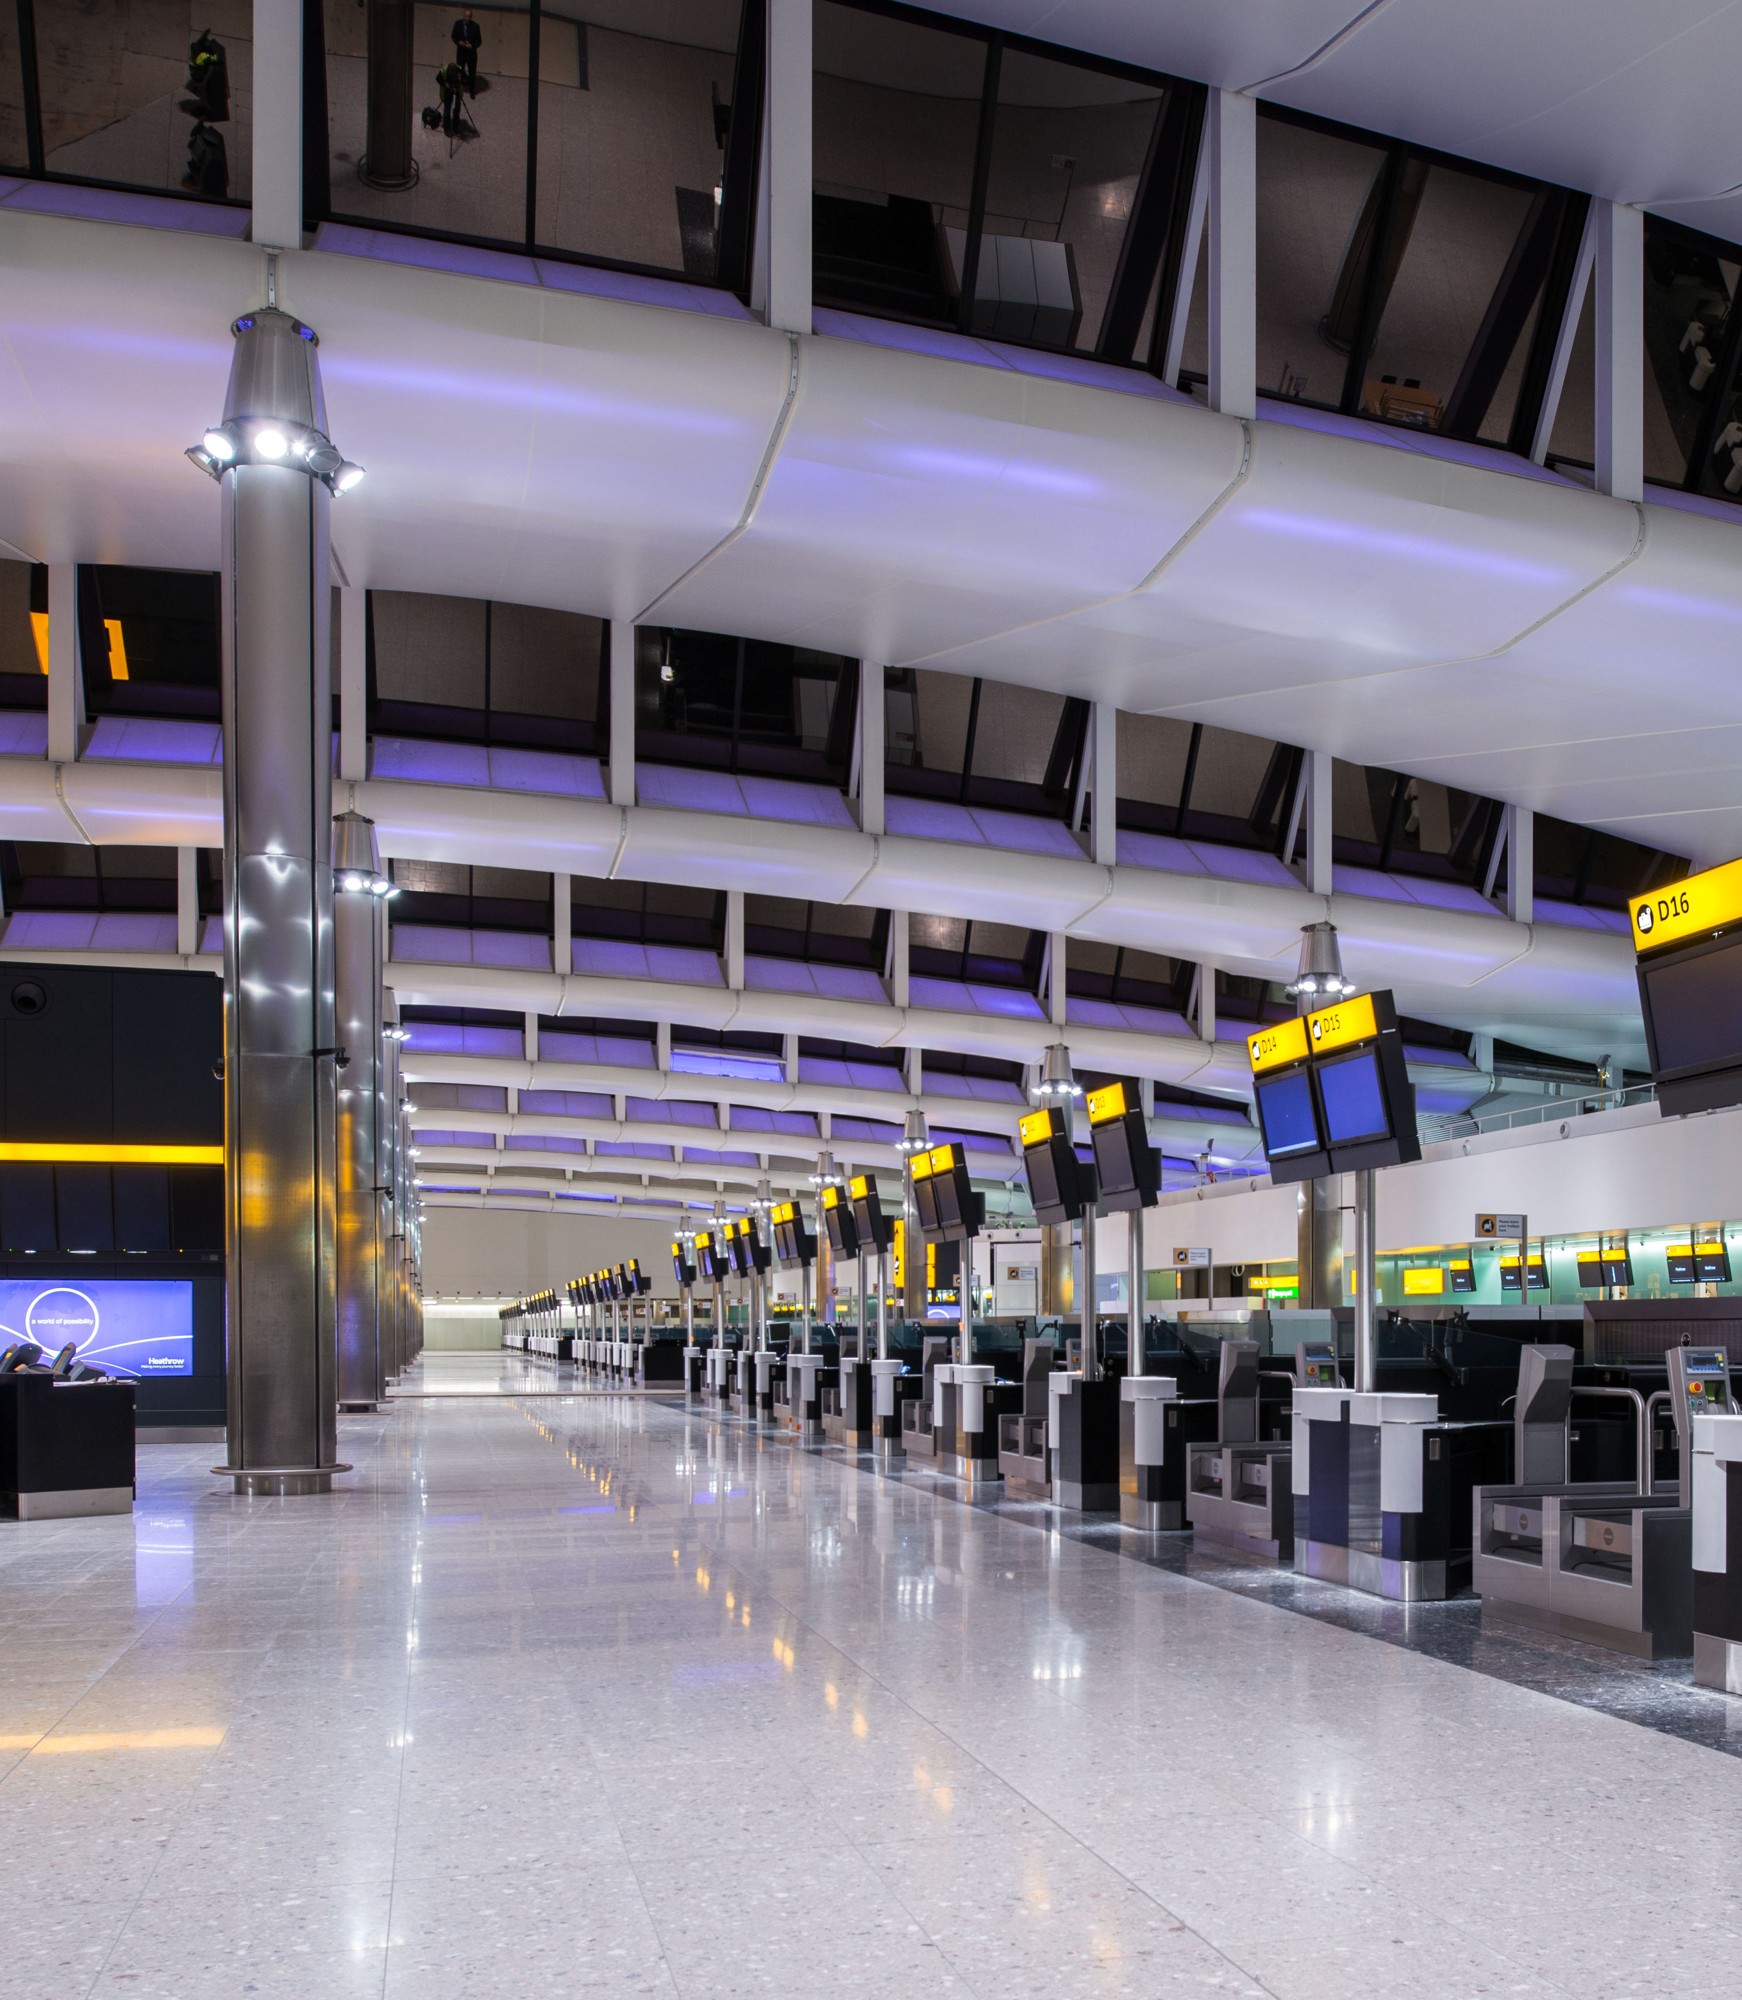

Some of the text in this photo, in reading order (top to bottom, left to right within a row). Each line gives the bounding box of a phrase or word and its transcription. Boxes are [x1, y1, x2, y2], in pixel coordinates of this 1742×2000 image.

[1657, 892, 1689, 922] D16
[1323, 1014, 1341, 1033] D15
[1261, 1035, 1277, 1053] D14
[63, 1318, 94, 1326] possibility
